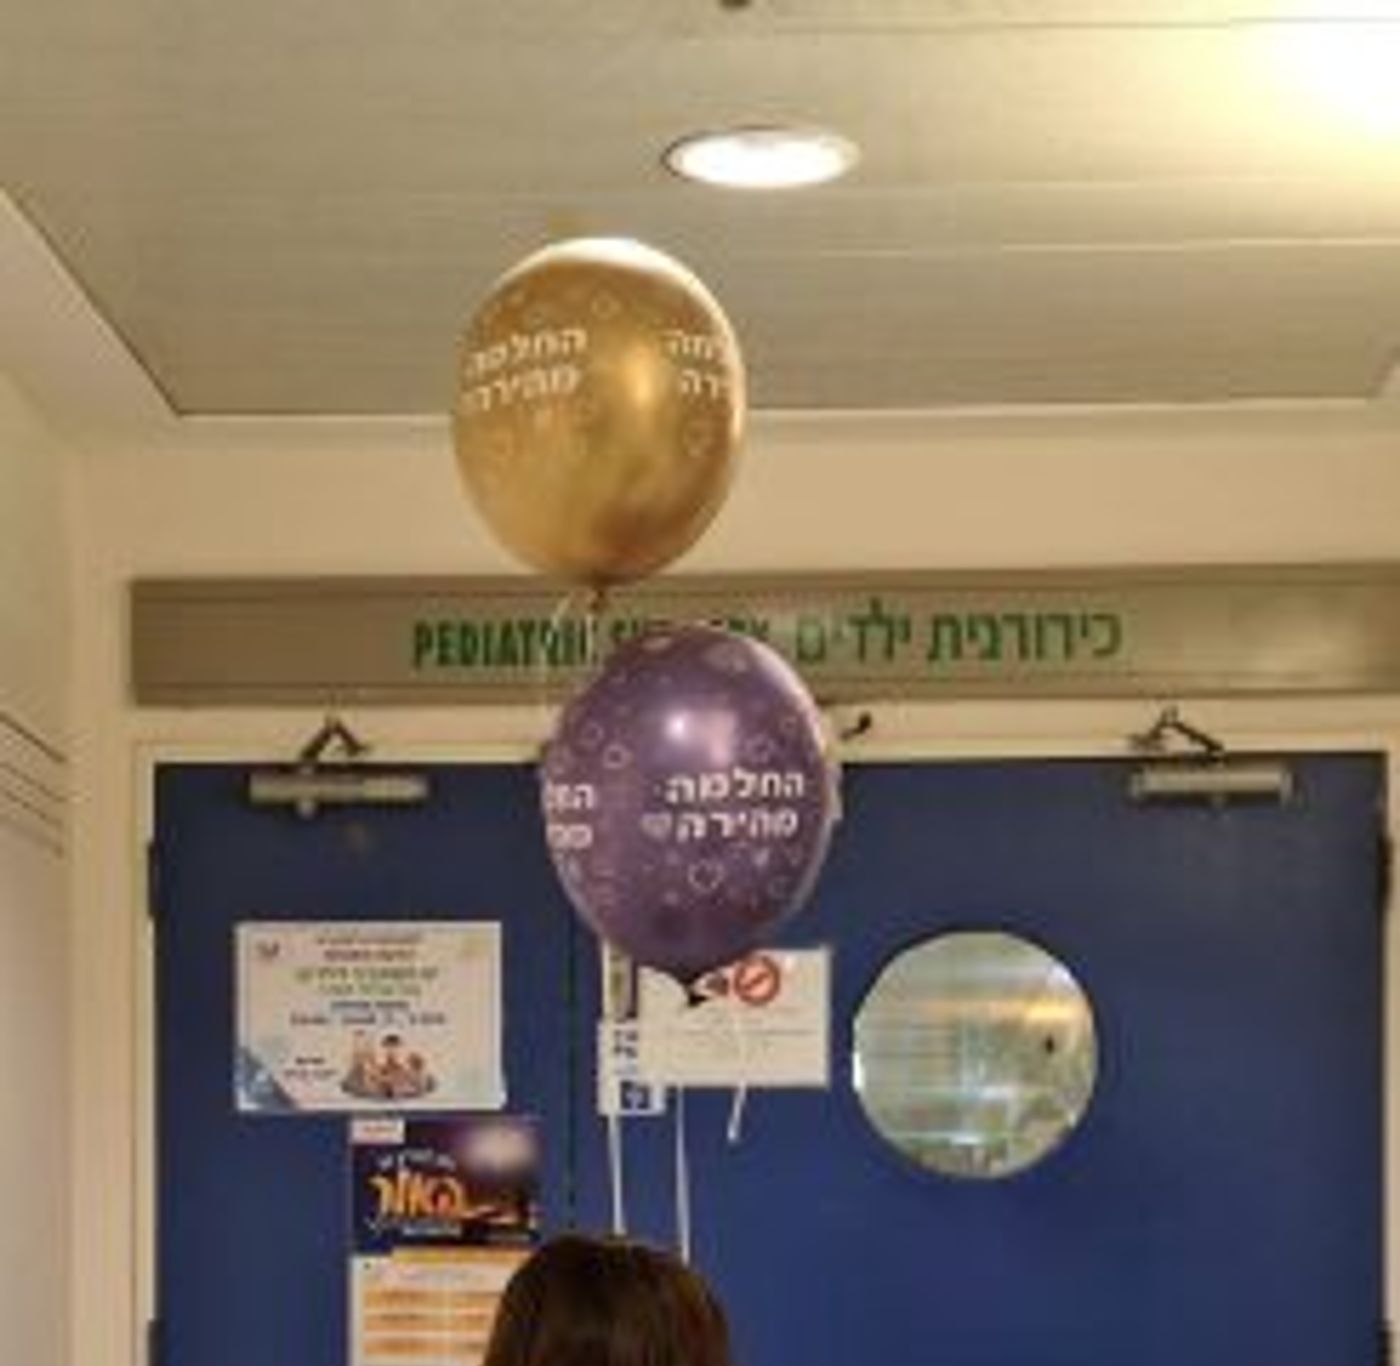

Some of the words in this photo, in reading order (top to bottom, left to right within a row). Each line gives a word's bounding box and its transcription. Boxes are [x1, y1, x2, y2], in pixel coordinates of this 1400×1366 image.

[795, 596, 912, 664] ילדים
[927, 610, 1123, 663] כירורגית
[664, 766, 806, 804] החלמה
[676, 809, 799, 843] מהירה
